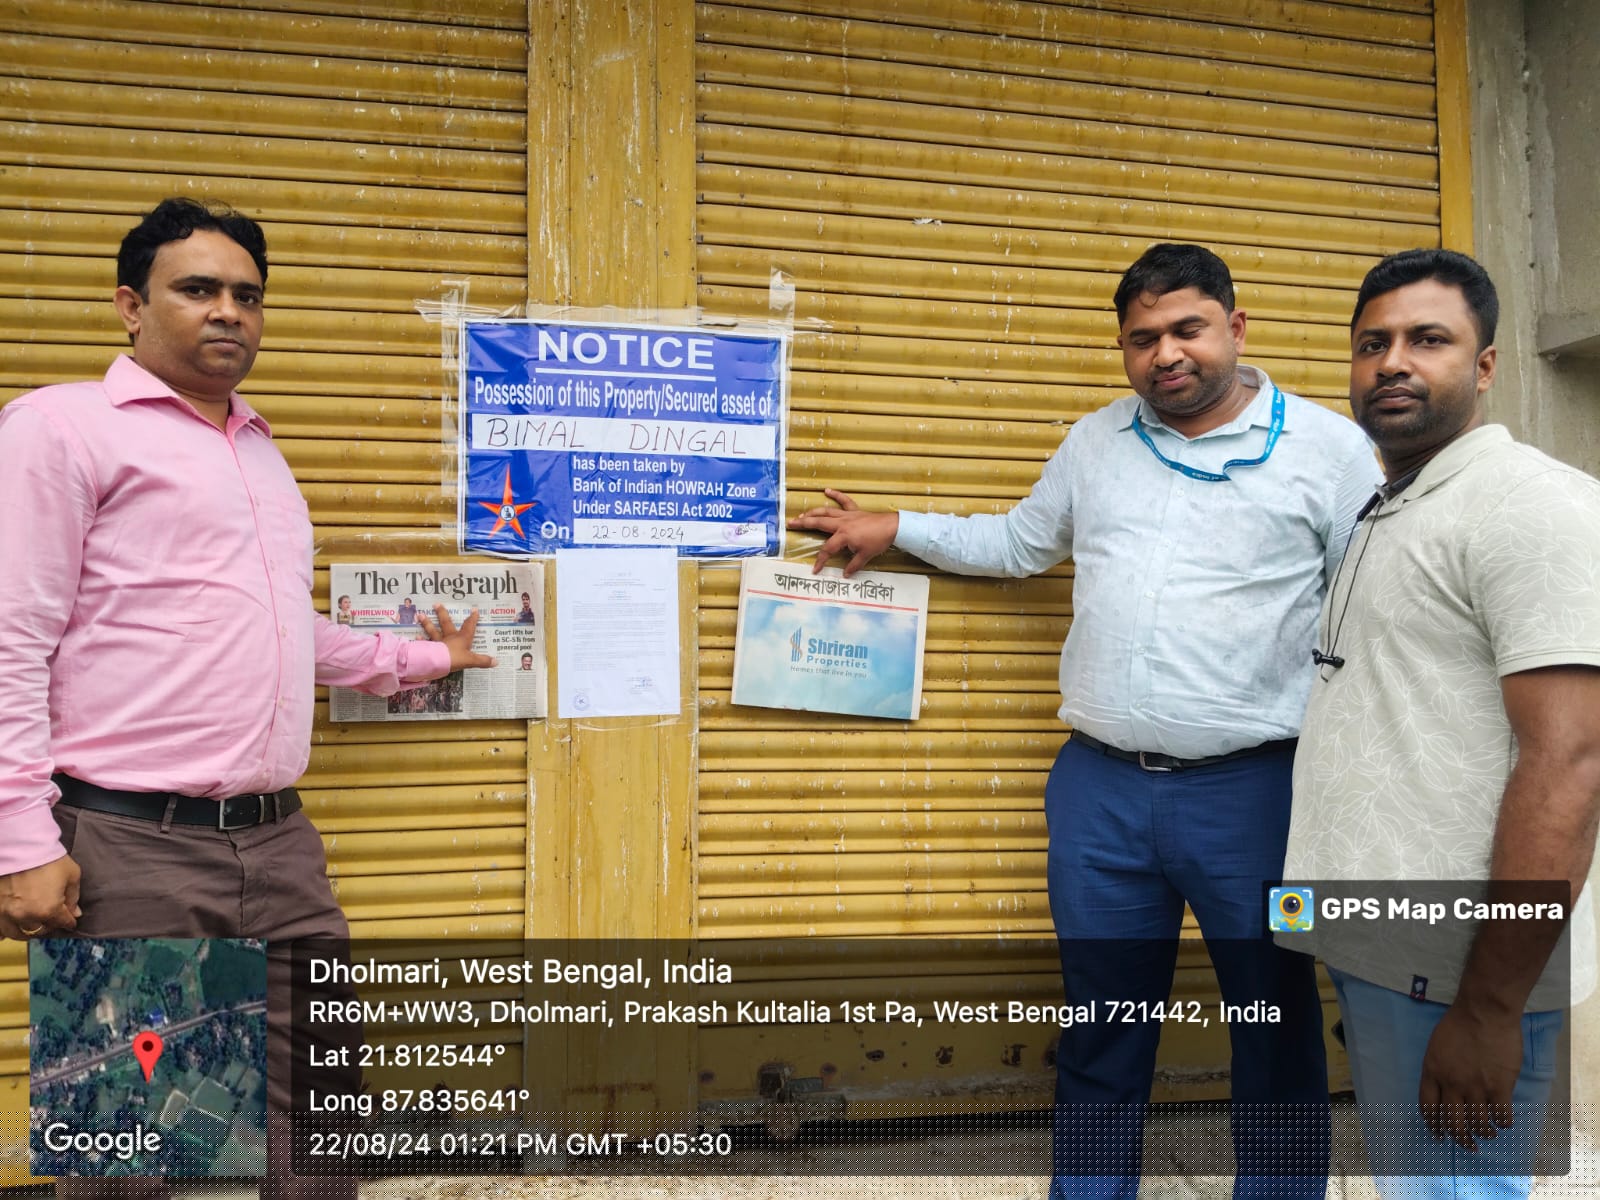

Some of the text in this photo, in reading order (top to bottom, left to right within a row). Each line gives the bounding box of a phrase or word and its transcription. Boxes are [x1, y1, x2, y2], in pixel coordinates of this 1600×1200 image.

[538, 330, 715, 370] NOTICE
[475, 376, 772, 417] Possession of this Property/Secured asset of
[487, 417, 746, 454] BIMAL DINGAL
[573, 455, 686, 477] has been taken by
[573, 477, 757, 498] Bank of Indian HOWRAH Zone
[573, 499, 733, 519] Under SARFAESI Act 2002
[541, 521, 570, 541] On
[354, 569, 519, 601] The Telegraph
[774, 573, 895, 603] আনন্দবাজার পত্রিকা
[350, 609, 396, 617] WHIRLWIND
[490, 607, 516, 615] ACTION
[807, 638, 869, 660] Shriram
[806, 655, 868, 670] Properties
